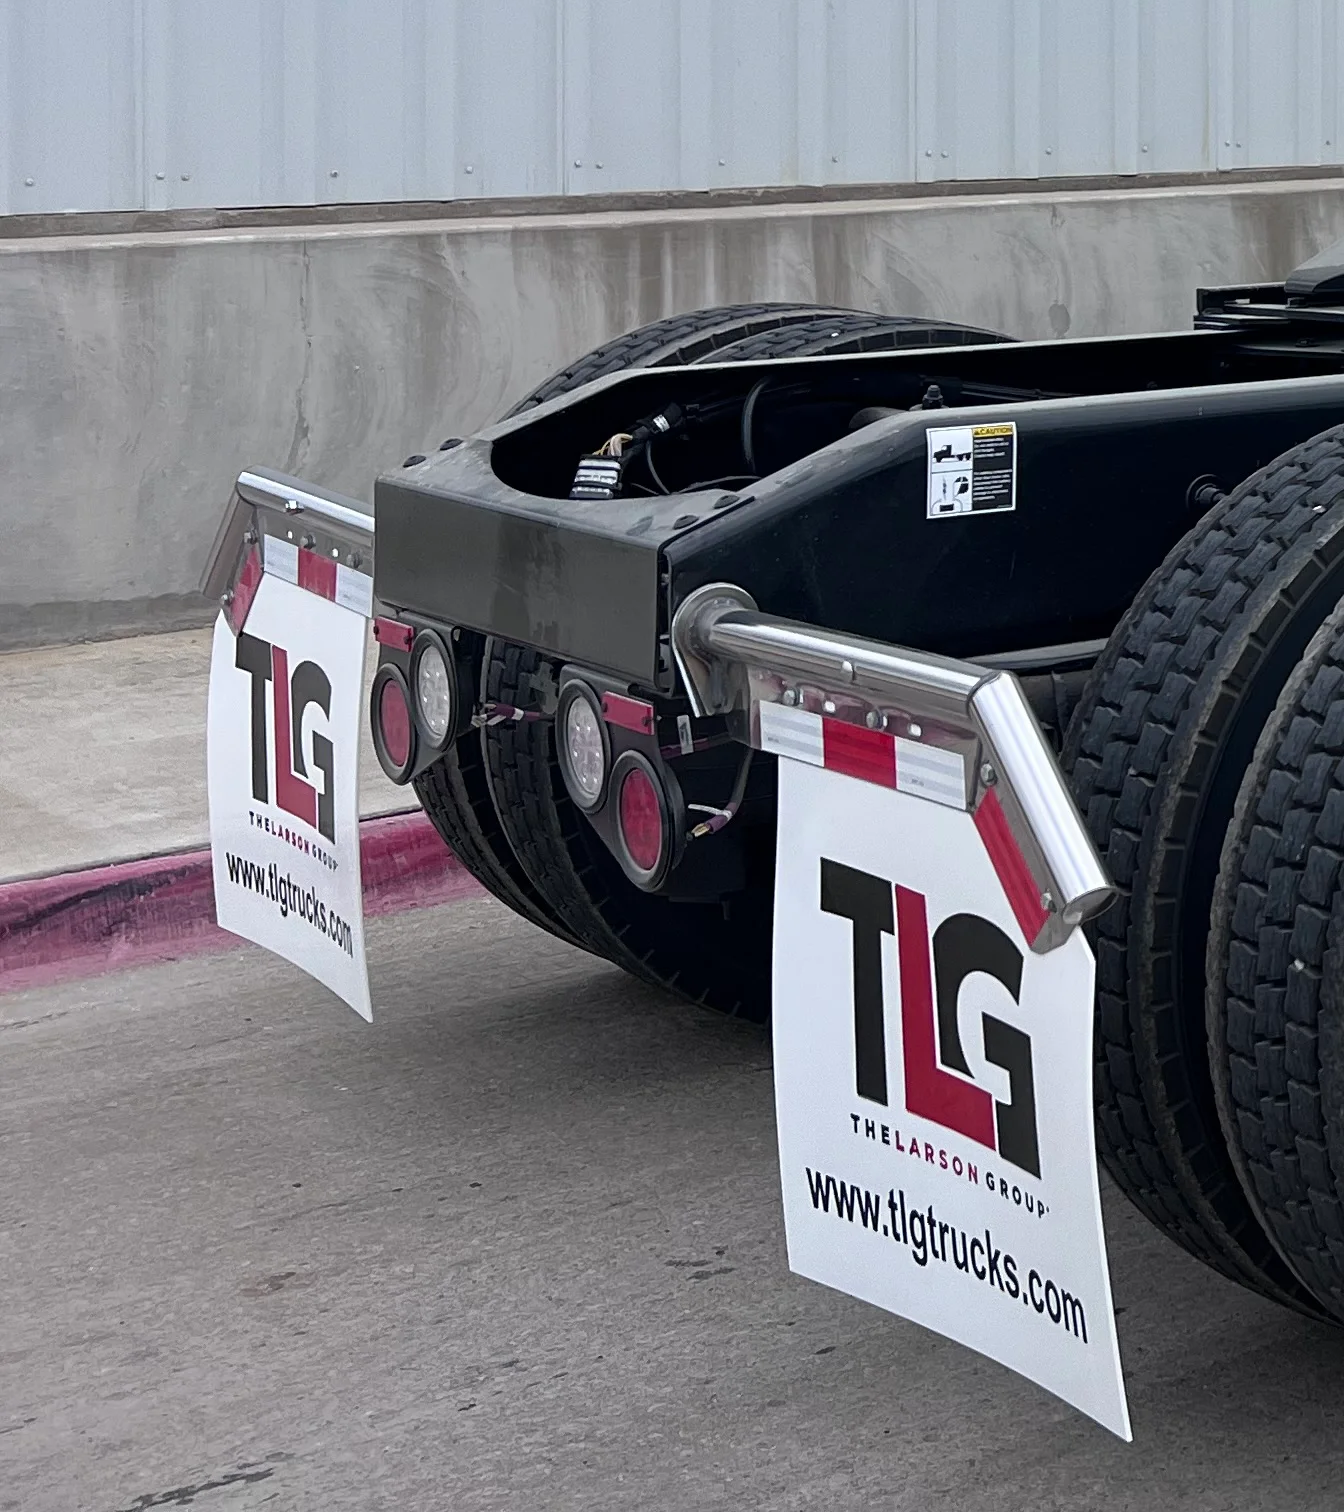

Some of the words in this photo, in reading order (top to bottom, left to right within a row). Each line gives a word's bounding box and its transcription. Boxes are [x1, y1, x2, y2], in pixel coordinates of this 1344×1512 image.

[235, 632, 335, 845] TLG
[226, 851, 353, 958] www.tlgtrucks.com
[819, 856, 1041, 1180] TLG
[806, 1167, 1088, 1344] www.tlgtrucks.com
[985, 1171, 1046, 1219] GROUP
